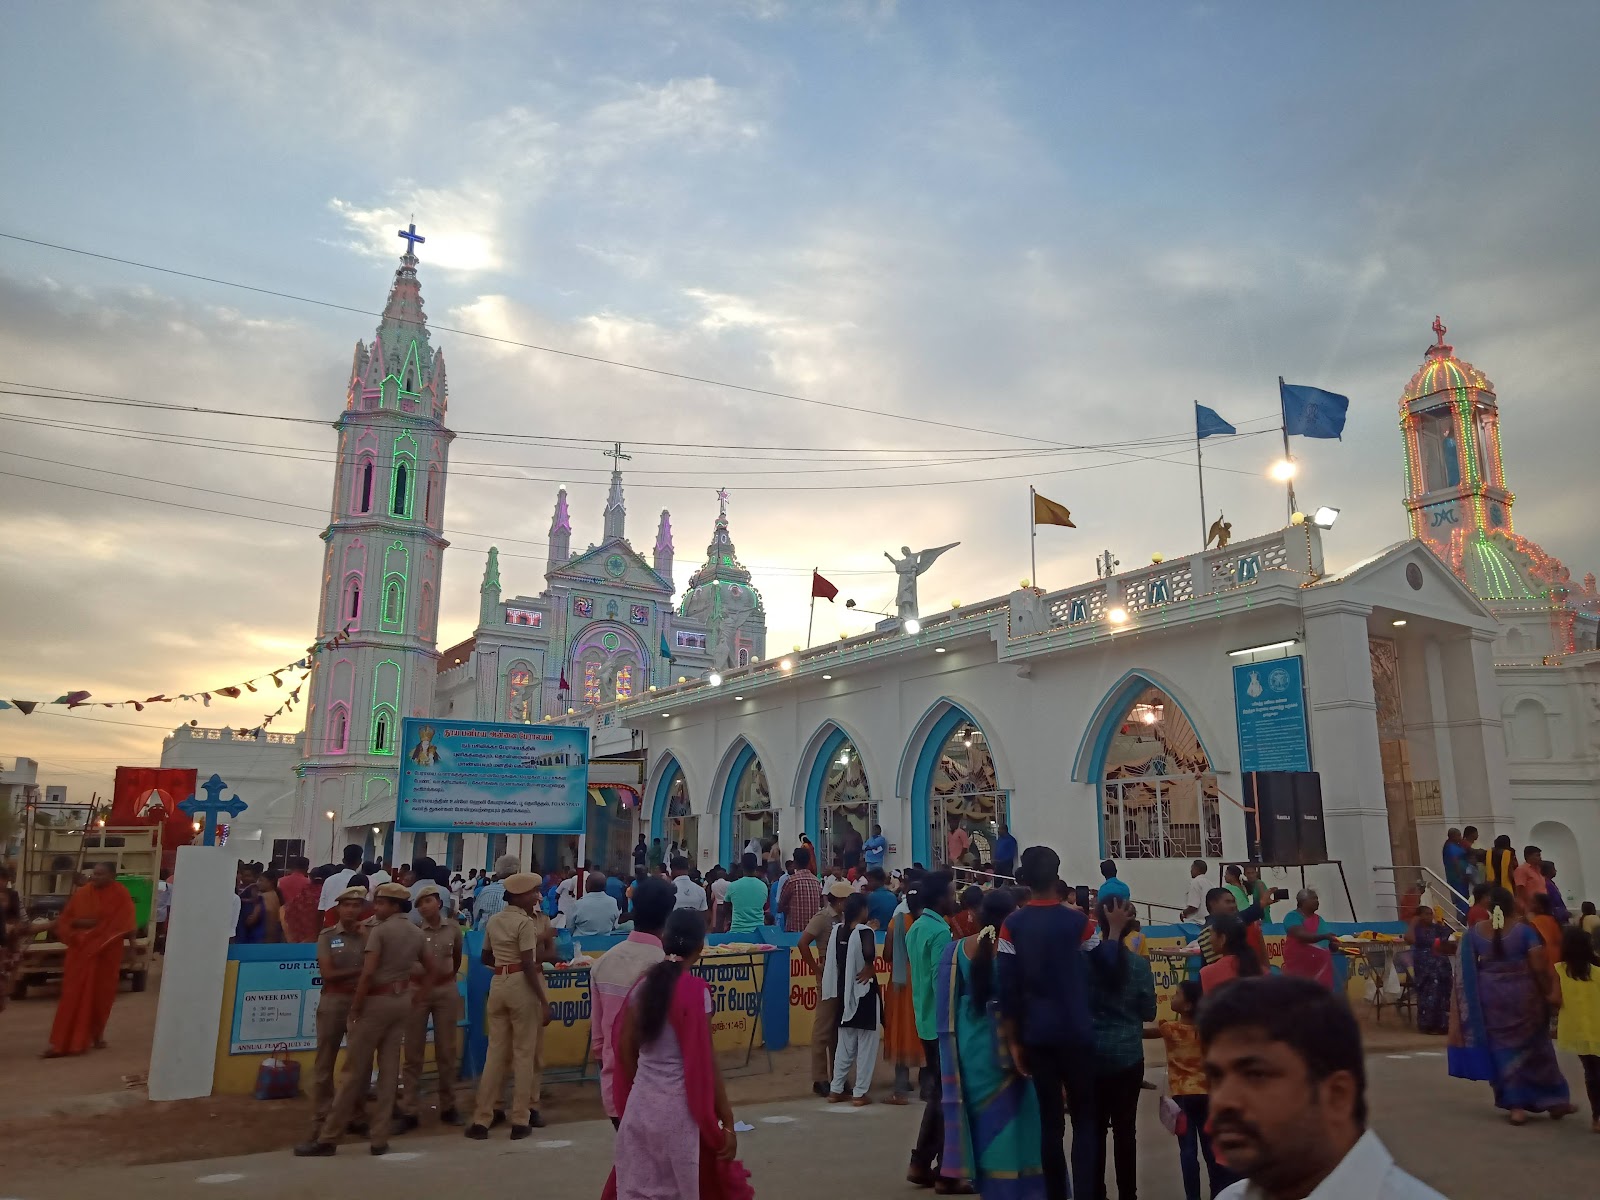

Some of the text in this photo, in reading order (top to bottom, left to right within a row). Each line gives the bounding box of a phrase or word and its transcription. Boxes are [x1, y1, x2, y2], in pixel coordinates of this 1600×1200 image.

[489, 729, 518, 739] அன்னை
[279, 962, 301, 970] OUR
[728, 987, 762, 1017] பேறு
